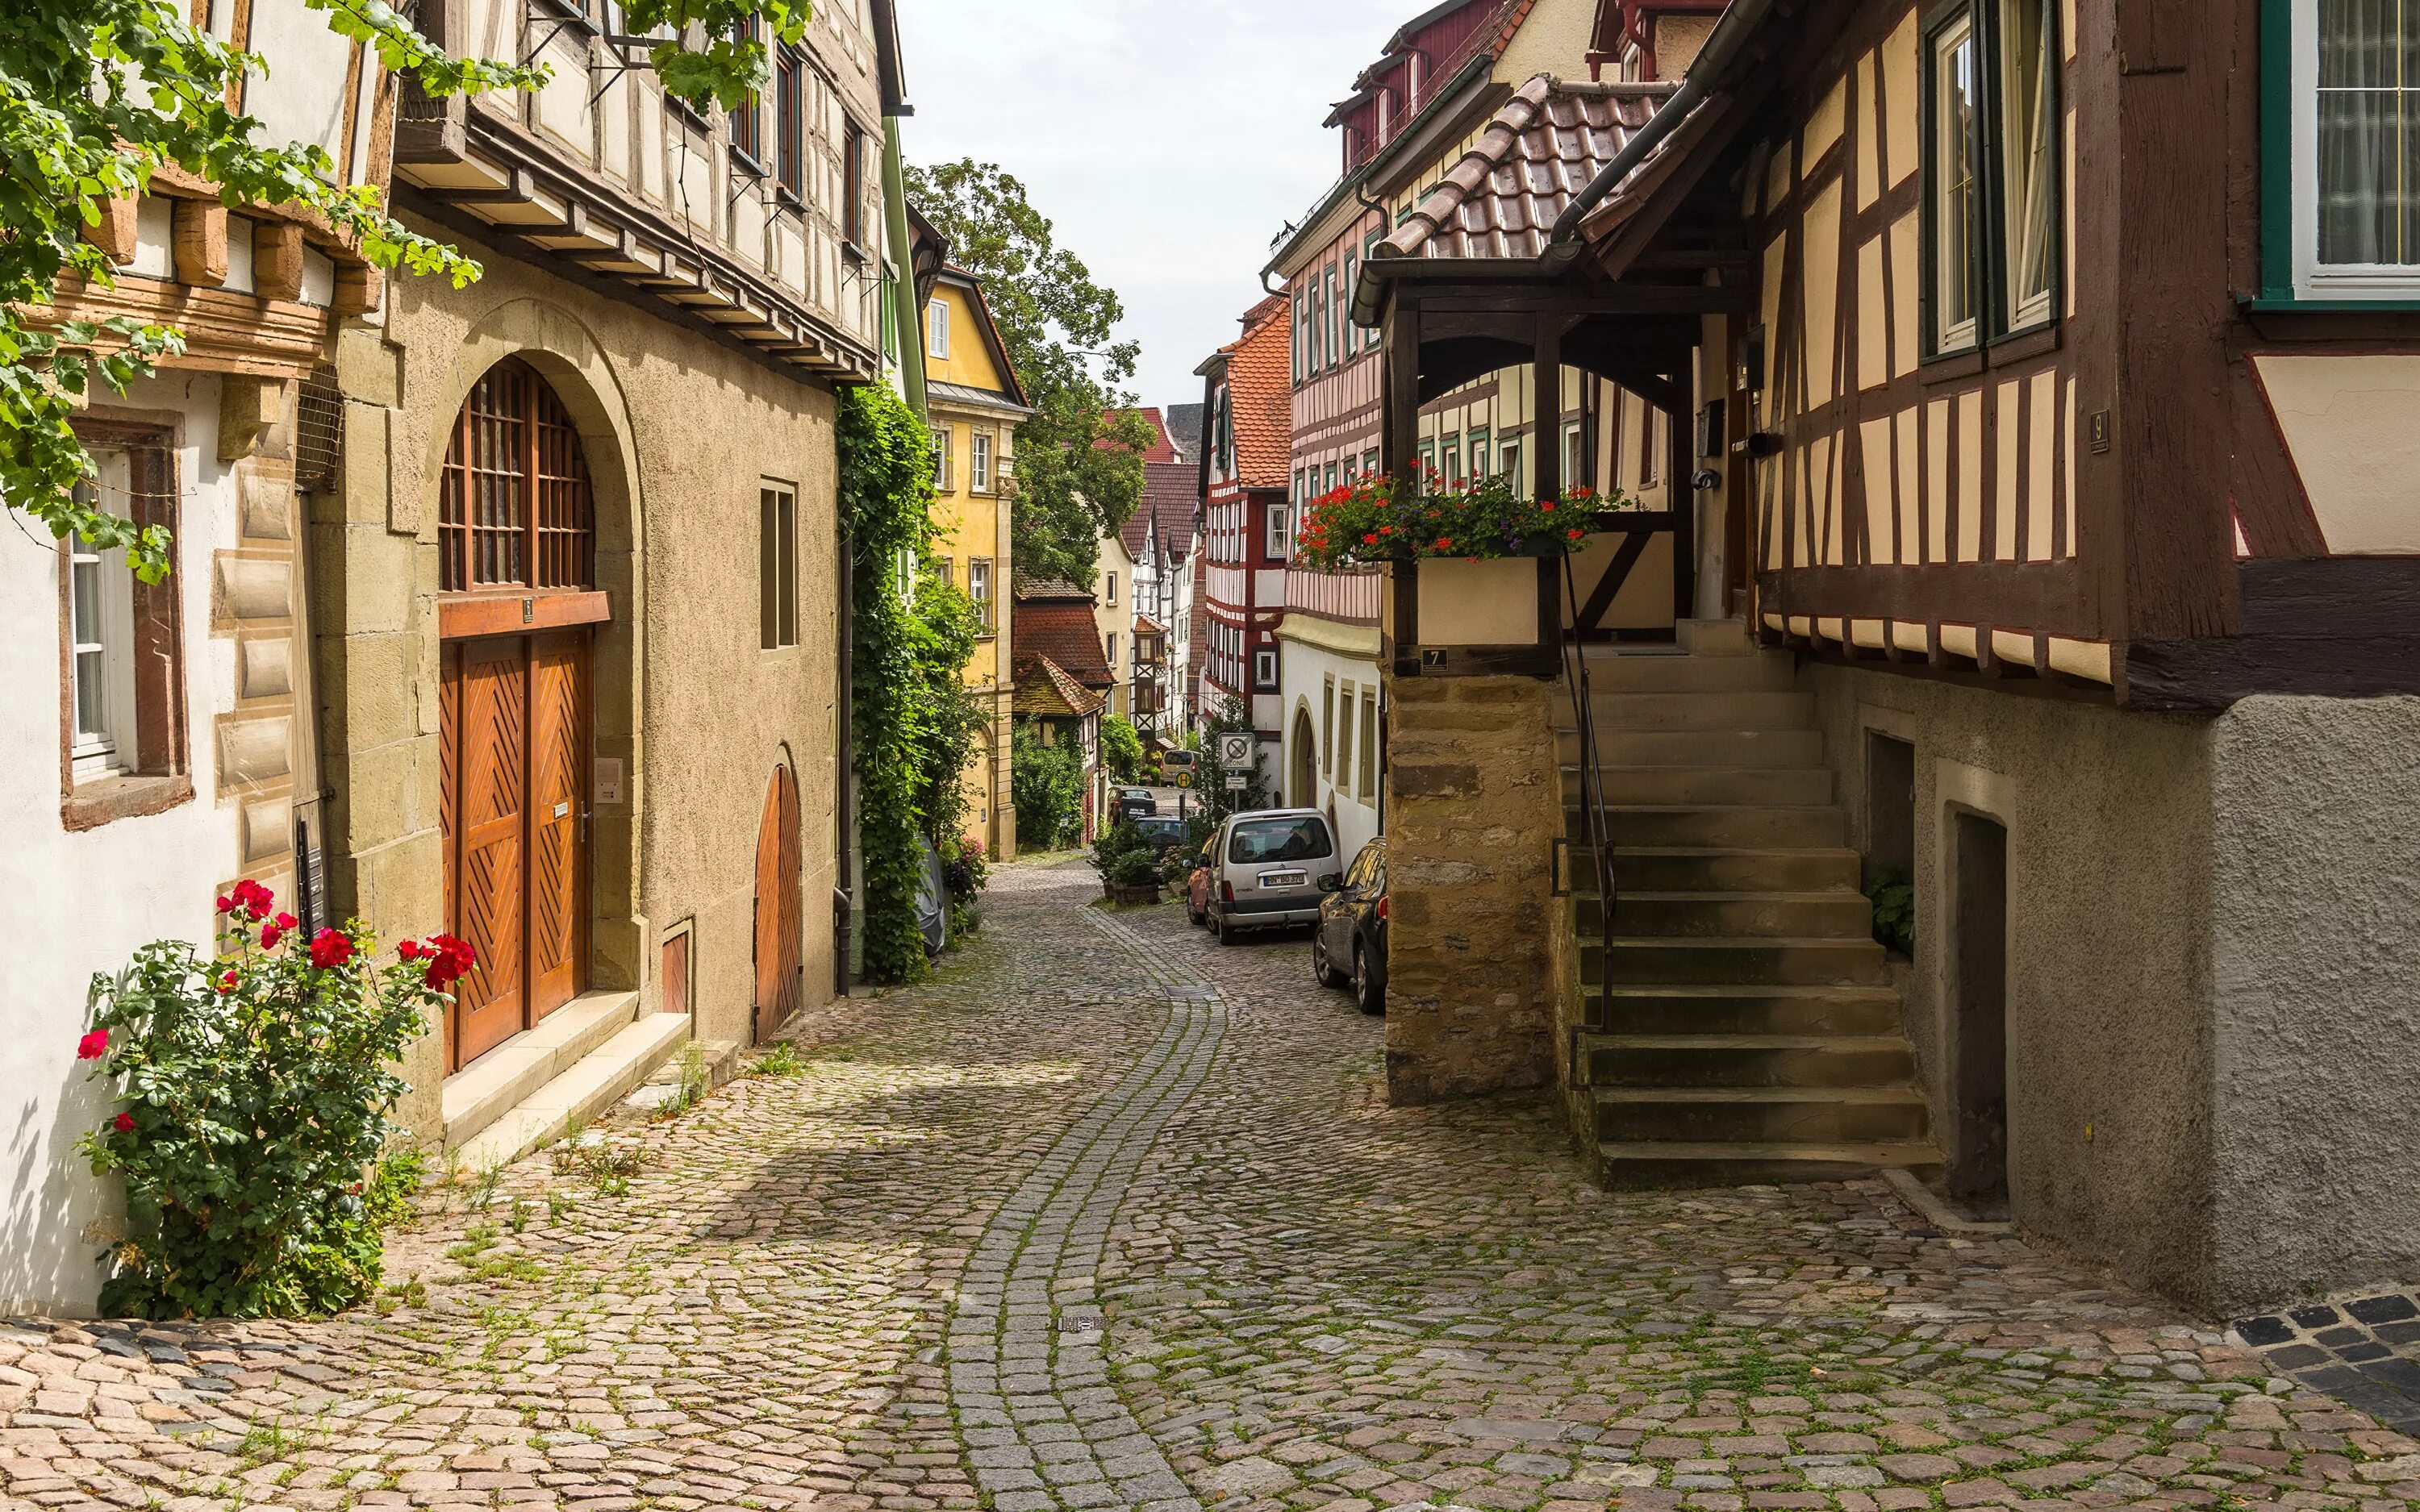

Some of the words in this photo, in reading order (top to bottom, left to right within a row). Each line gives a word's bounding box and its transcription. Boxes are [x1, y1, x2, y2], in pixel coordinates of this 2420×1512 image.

[2096, 414, 2102, 440] 9
[1431, 651, 1439, 665] 7
[1180, 775, 1187, 785] H
